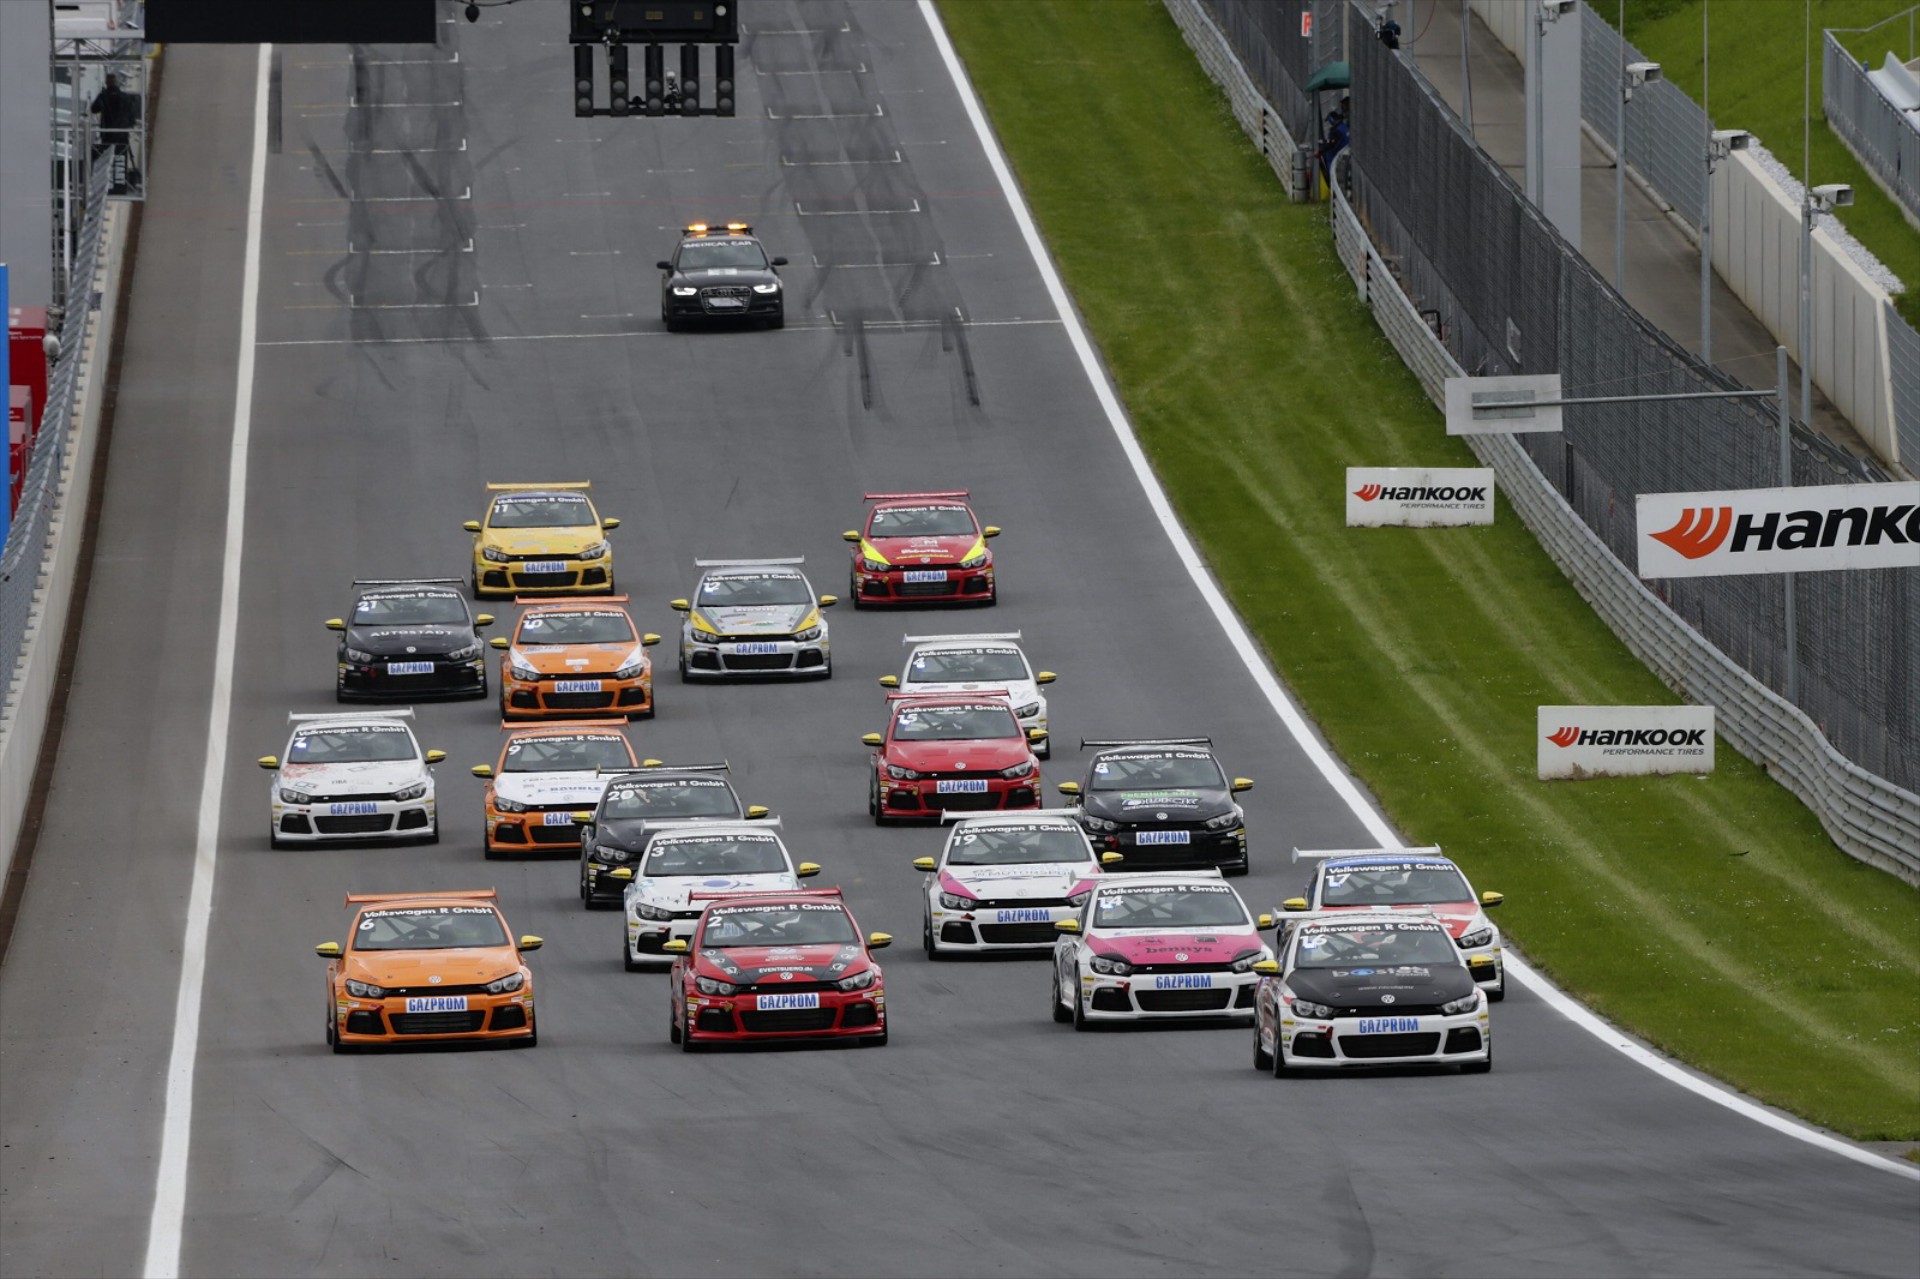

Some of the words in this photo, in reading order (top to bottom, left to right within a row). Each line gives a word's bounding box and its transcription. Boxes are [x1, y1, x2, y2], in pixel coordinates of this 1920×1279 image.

[494, 505, 508, 513] 11
[357, 601, 377, 611] 21
[557, 681, 599, 691] GAZPROM
[299, 728, 359, 736] Volkswagen
[509, 746, 521, 755] 9
[613, 782, 676, 790] Volkswagen
[939, 781, 985, 792] GAZPROM
[608, 790, 634, 801] 20
[331, 803, 377, 814] GAZPROM
[959, 826, 1025, 834] Volkswagen
[656, 837, 723, 845] Volkswagen
[954, 835, 977, 846] 19
[1139, 832, 1187, 843] GAZPROM
[651, 847, 665, 857] 3
[1329, 865, 1399, 874] Volkswagen
[1326, 874, 1351, 887] 17
[1102, 887, 1174, 896] Volkswagen
[364, 909, 436, 918] Volkswagen
[713, 905, 785, 915] Volkswagen
[997, 910, 1049, 922] GAZPROM
[359, 919, 375, 930] 6
[707, 917, 723, 927] 2
[1304, 925, 1380, 934] Volkswagen
[1398, 924, 1439, 932] GmbH
[1156, 975, 1211, 988] GAZPROM
[409, 997, 465, 1011] GAZPROM
[760, 995, 816, 1008] GAZPROM
[1359, 1019, 1418, 1034] GAZPROM
